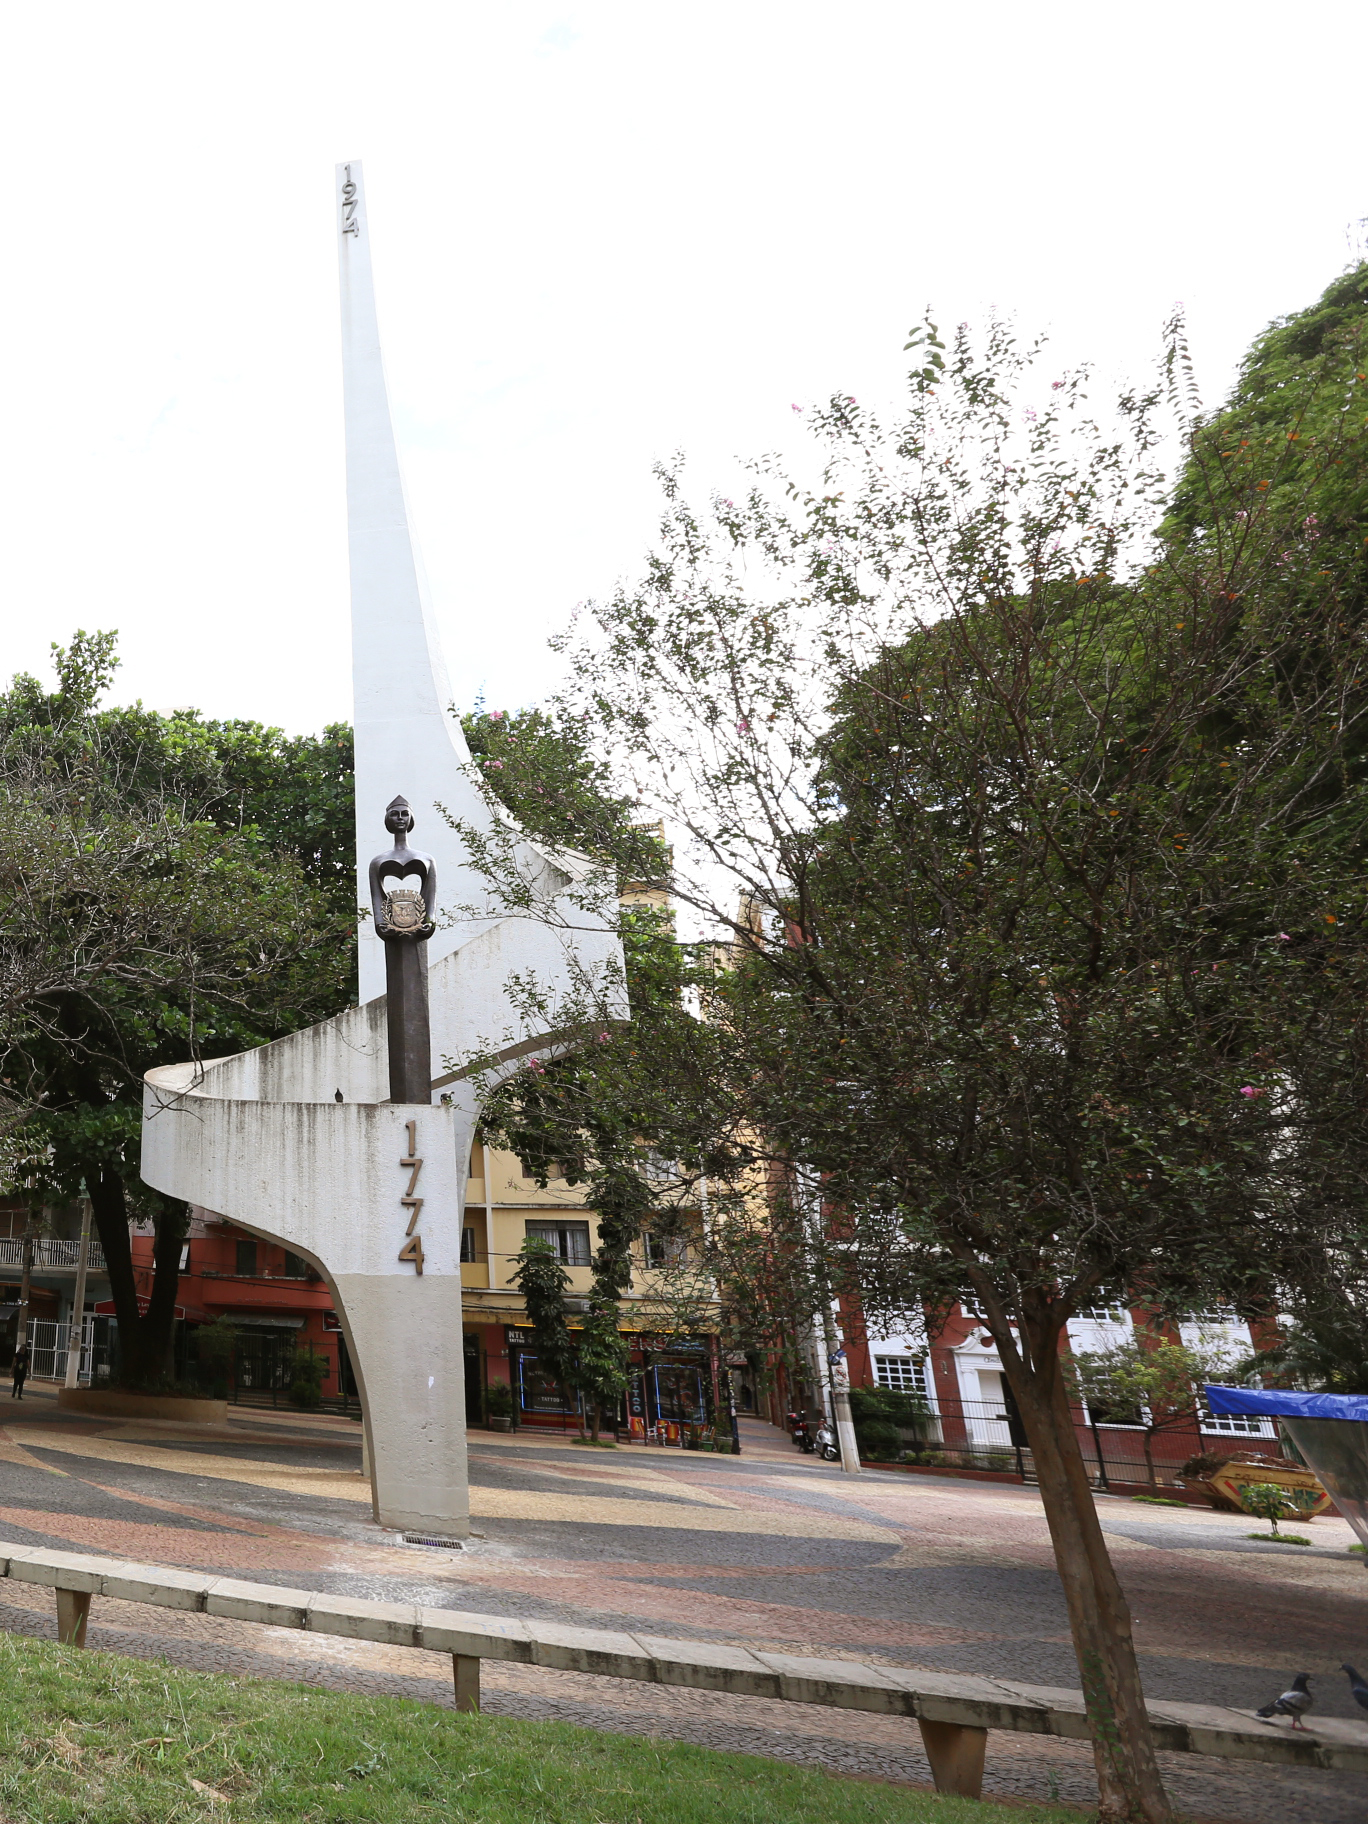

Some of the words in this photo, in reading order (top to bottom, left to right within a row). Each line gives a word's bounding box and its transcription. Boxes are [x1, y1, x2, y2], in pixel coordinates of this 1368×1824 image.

[342, 164, 359, 238] 1974
[398, 1120, 424, 1276] 1774
[631, 1366, 642, 1413] TTOO
